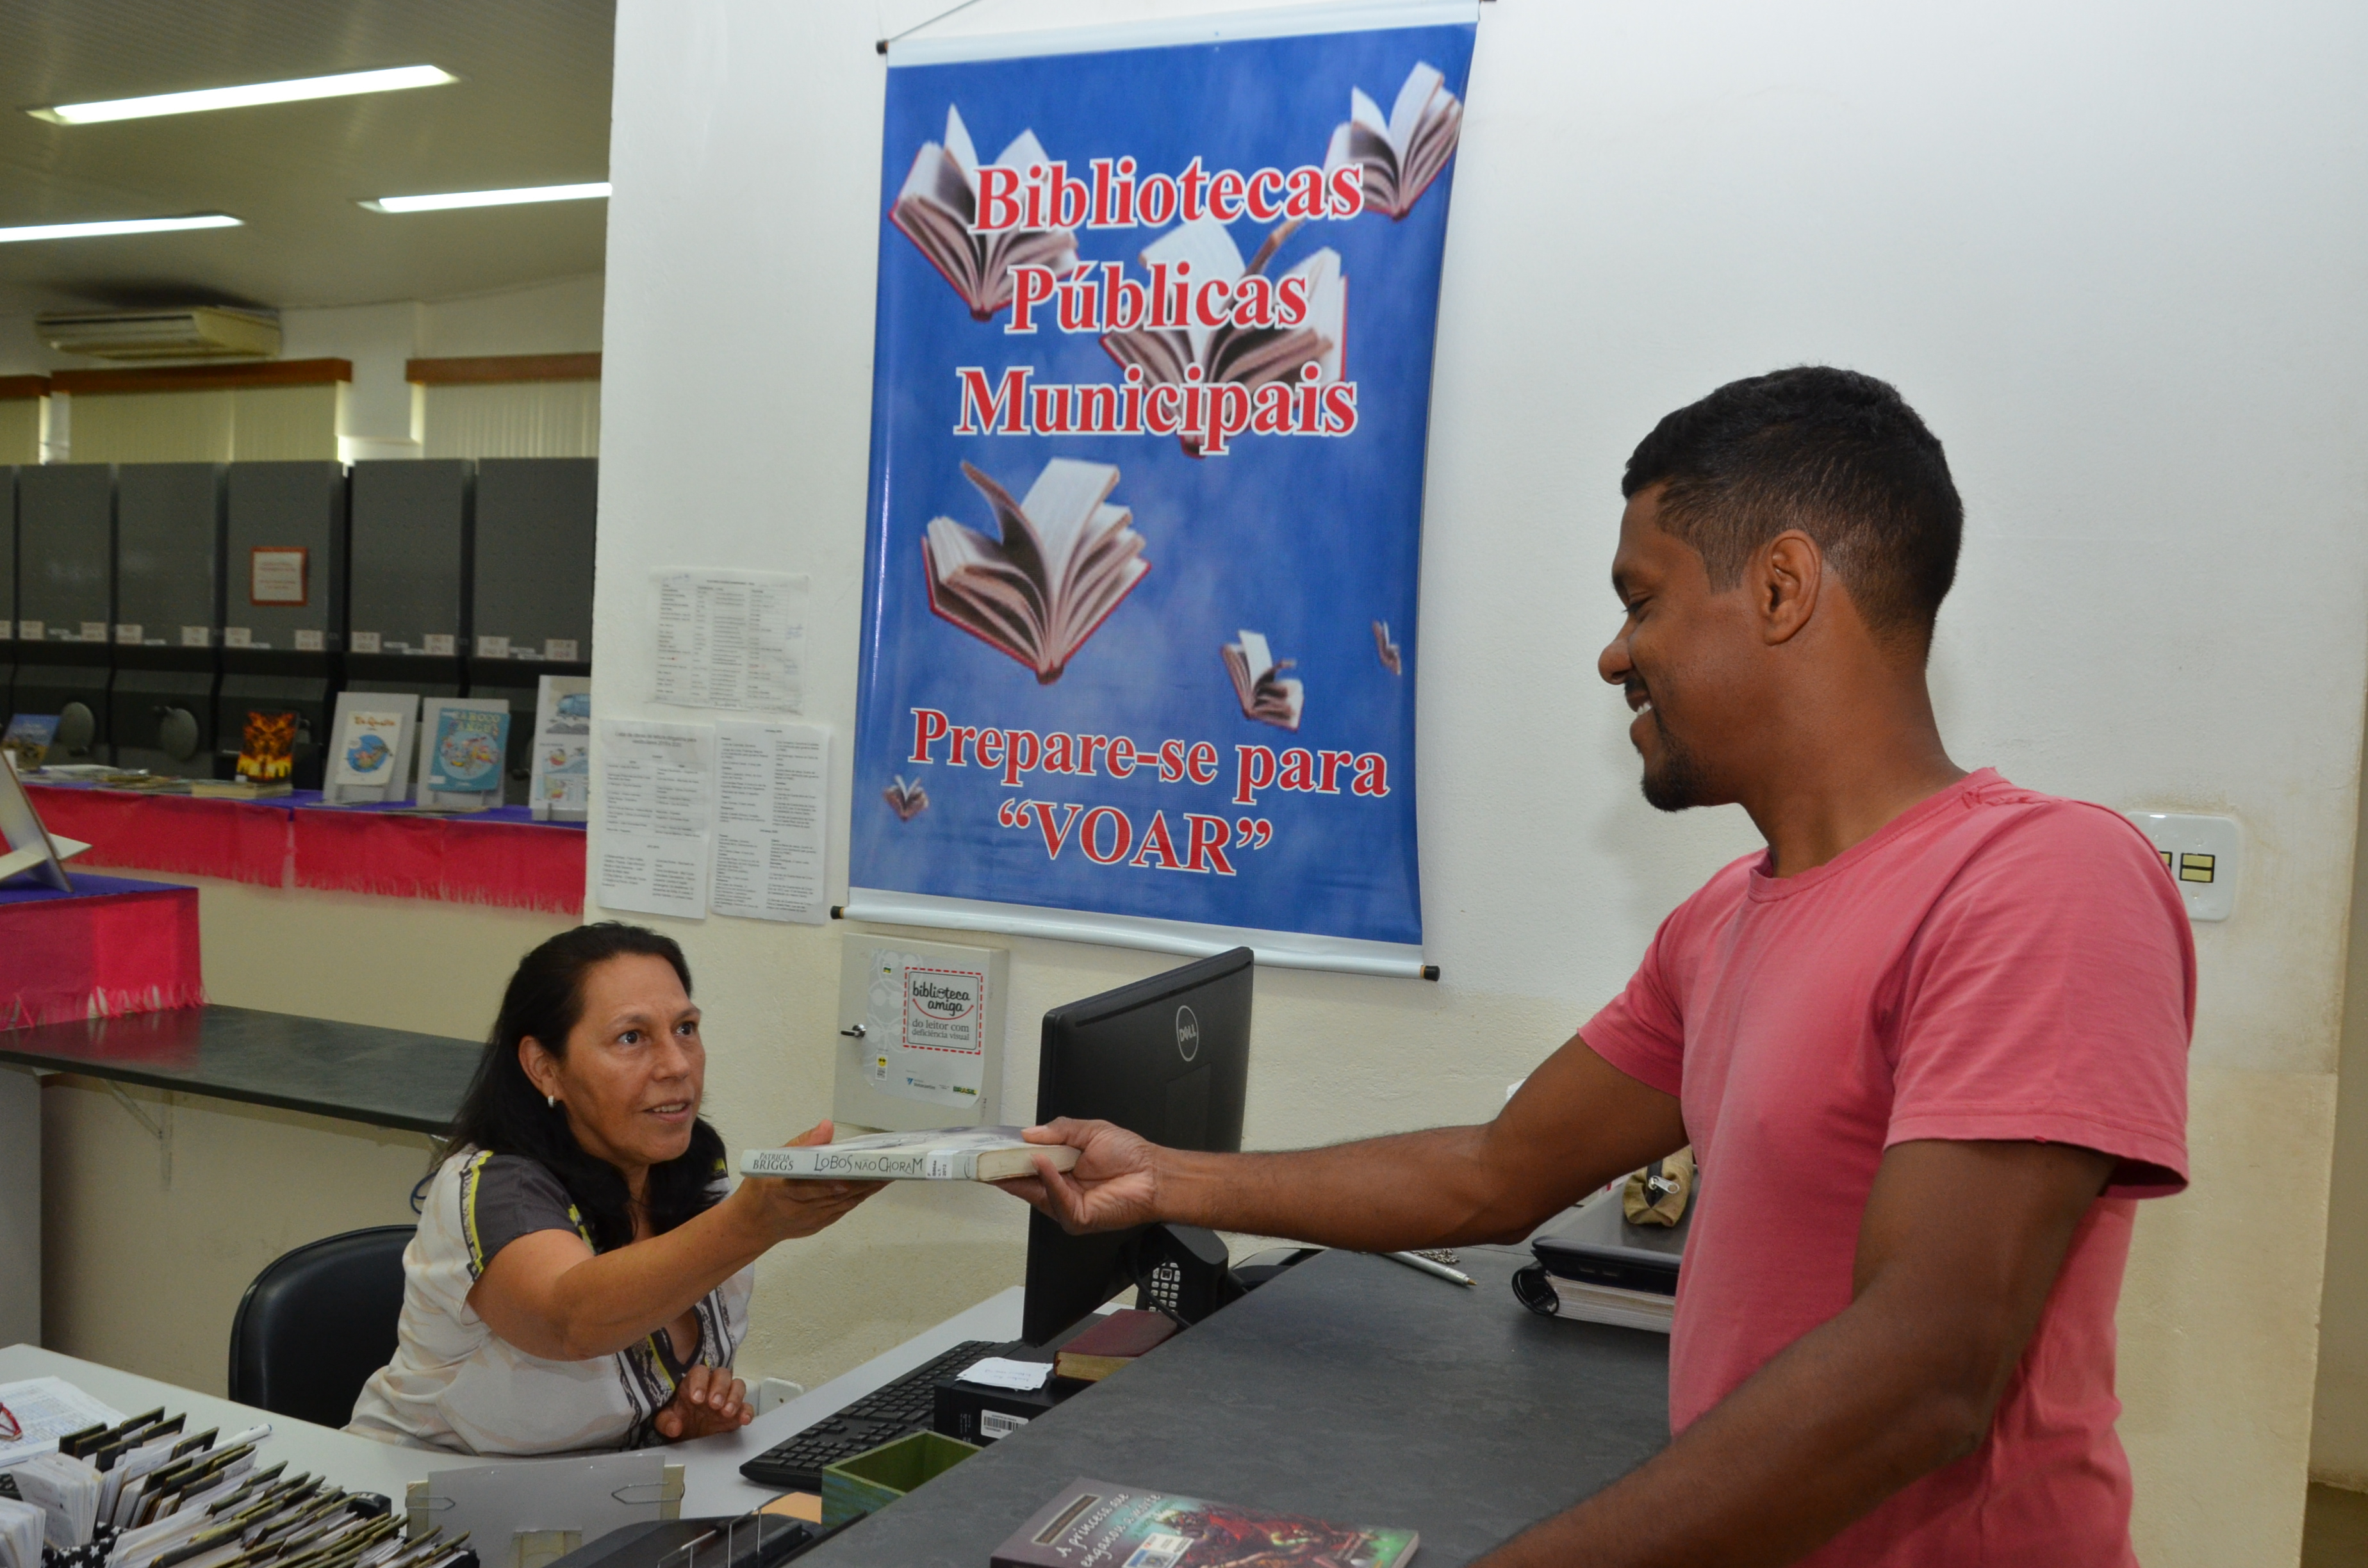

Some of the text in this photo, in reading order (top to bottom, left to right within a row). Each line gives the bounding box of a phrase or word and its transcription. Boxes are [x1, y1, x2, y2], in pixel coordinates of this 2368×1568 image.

[967, 156, 1363, 234] Bibliotecas
[1005, 259, 1308, 334] Públicas
[953, 361, 1359, 456] Municipais
[907, 707, 1218, 788] Prepare-se
[1233, 743, 1390, 806] para
[913, 981, 970, 1000] biblioteca
[928, 999, 964, 1017] amiga
[912, 1019, 969, 1033] do leitor com
[912, 1028, 969, 1040] deficiência visual
[1179, 1024, 1196, 1042] DELL
[953, 1086, 976, 1095] BRASIL
[752, 1159, 794, 1171] BRIGGS
[855, 1159, 876, 1172] NÃO
[1056, 1546, 1072, 1558] A
[1068, 1502, 1112, 1550] princesa
[1110, 1492, 1130, 1510] que
[1080, 1524, 1126, 1568] enganou
